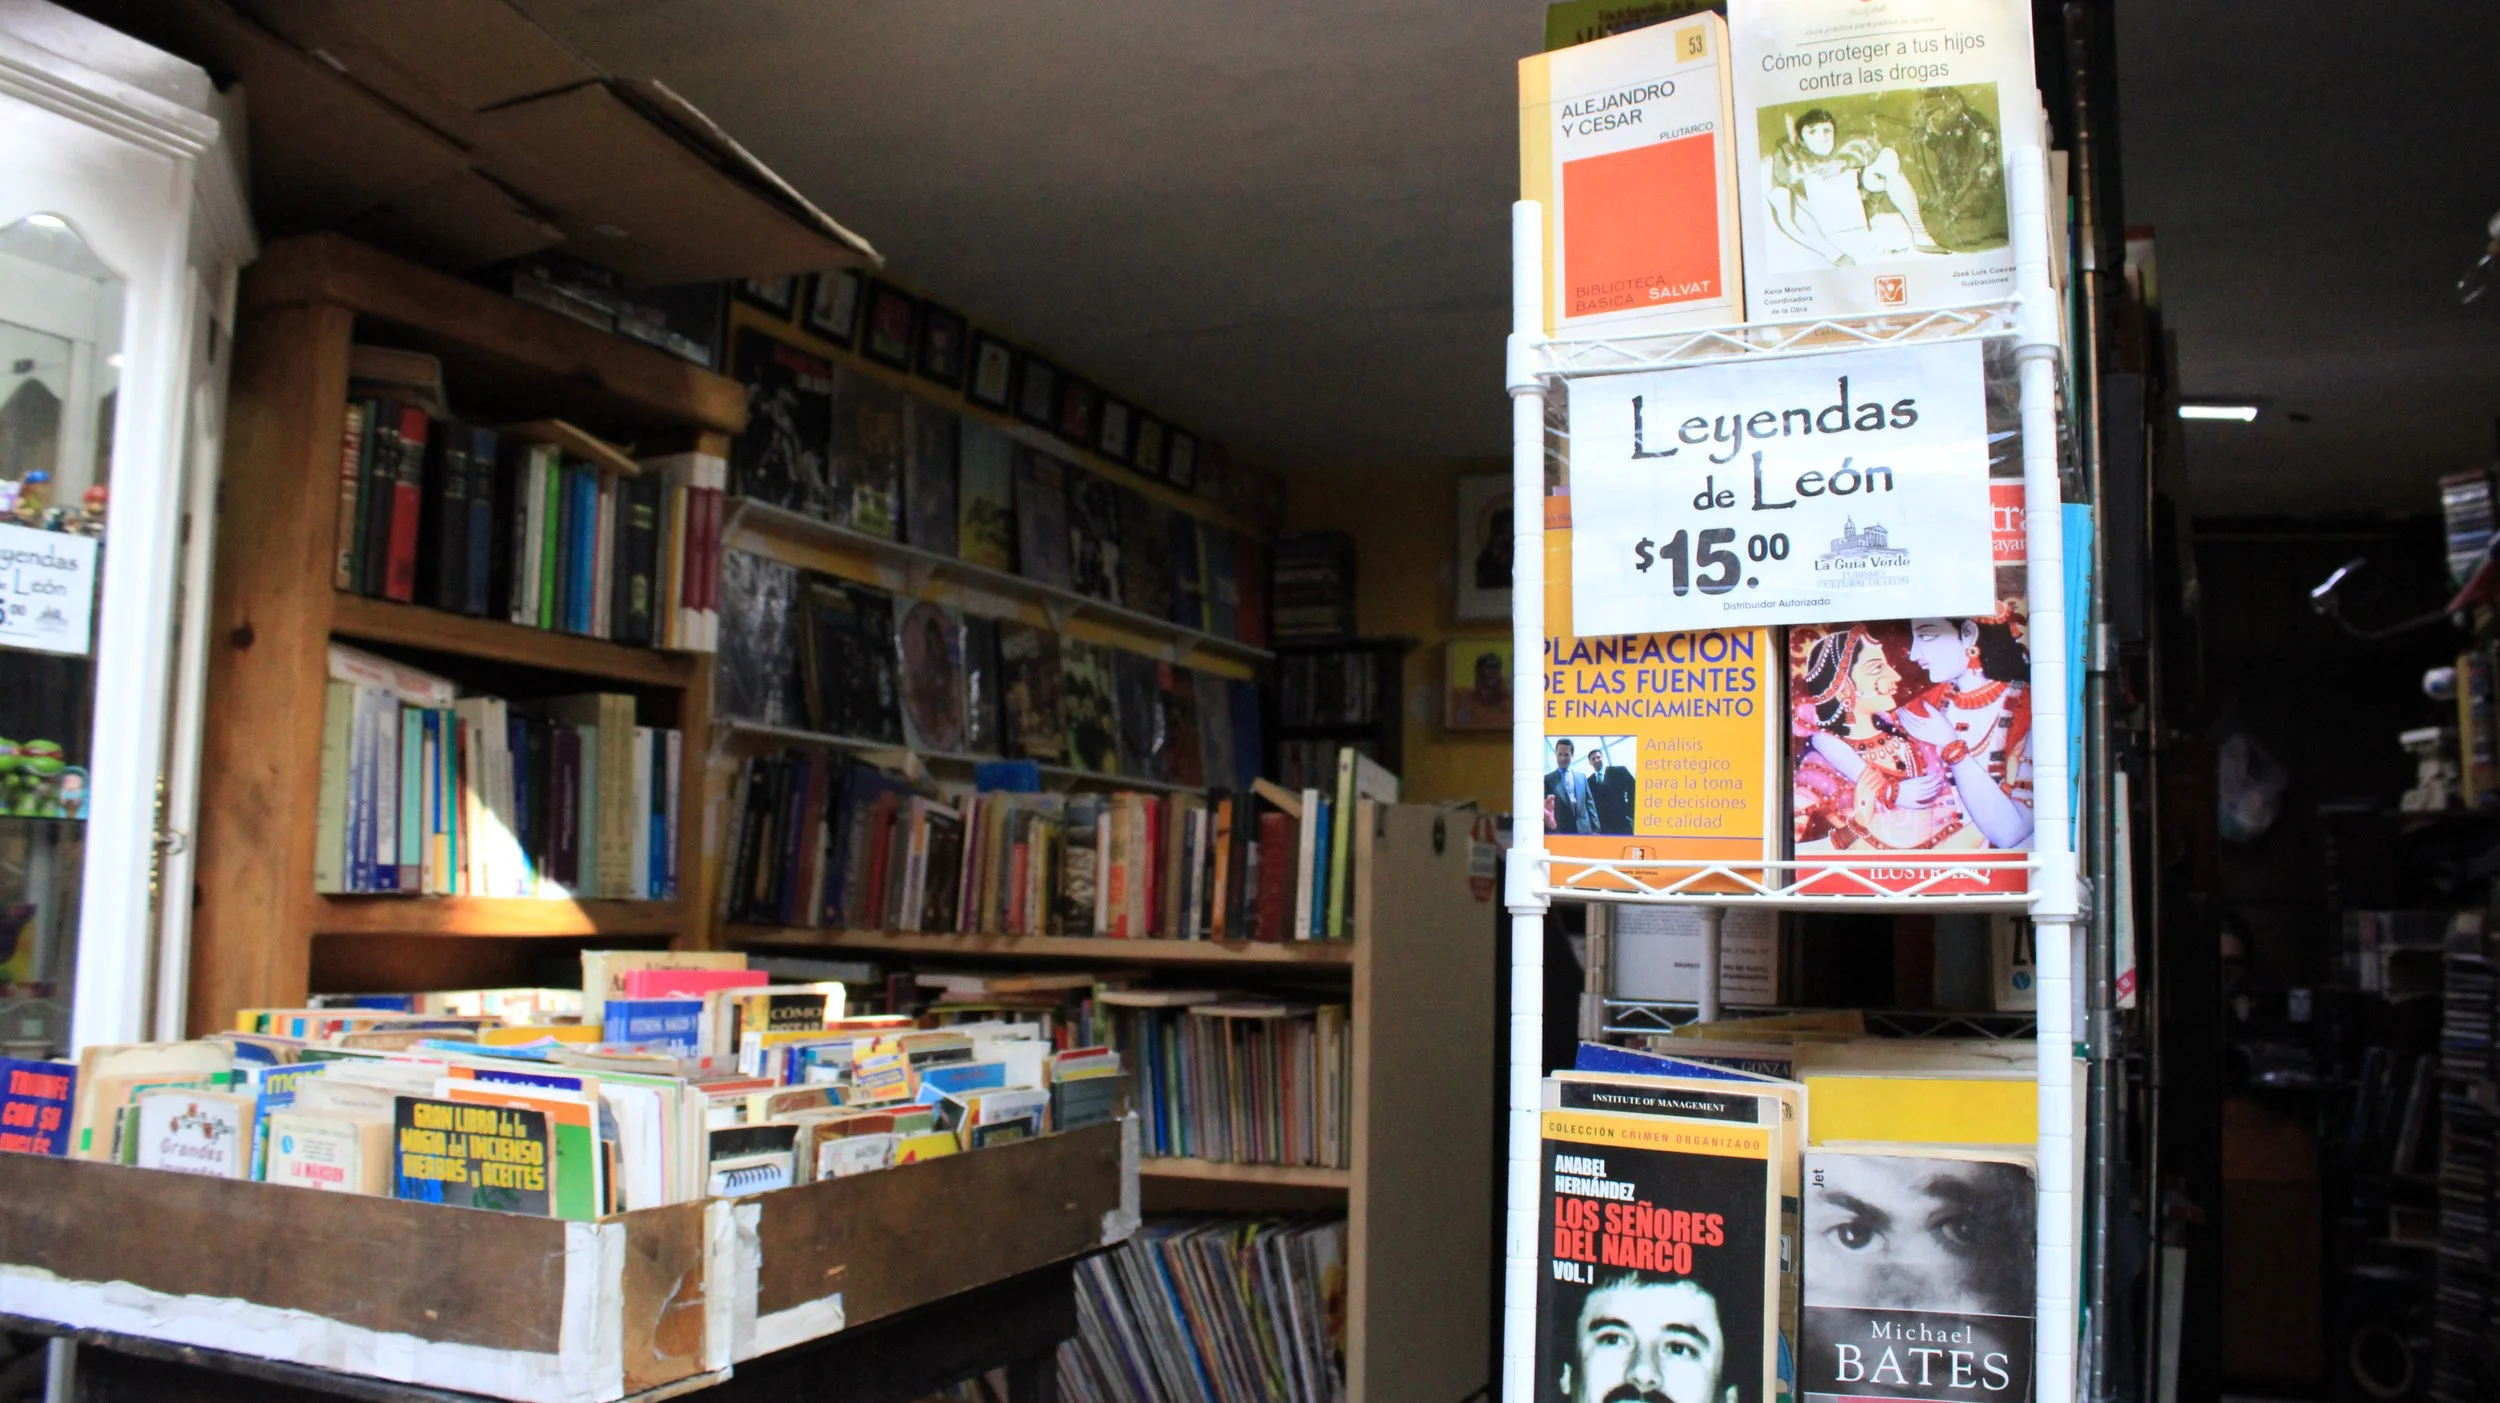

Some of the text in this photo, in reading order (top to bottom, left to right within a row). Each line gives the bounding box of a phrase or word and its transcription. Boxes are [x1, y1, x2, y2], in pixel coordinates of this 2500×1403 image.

[1688, 35, 1703, 55] 53
[1762, 32, 1985, 72] Cómo proteger a tus hijos
[1799, 63, 1949, 91] contra las drogas
[1561, 80, 1675, 120] ALEJANDRO
[1562, 109, 1643, 138] Y CESAR
[1659, 121, 1714, 141] PLUTARCO
[1971, 267, 1988, 276] Luis
[1576, 275, 1666, 299] BIBLIOTECA
[1648, 280, 1711, 300] SALVAT
[1576, 293, 1634, 313] BASICA
[1764, 295, 1813, 306] Coordinadora
[1631, 375, 1919, 464] Leyendas
[1693, 450, 1894, 511] de León
[1635, 527, 1790, 597] $15.00
[1814, 559, 1830, 571] La
[1870, 555, 1911, 568] Verde
[1723, 596, 1831, 612] Distribuidor Autorizado
[1577, 669, 1626, 694] LAS
[1637, 667, 1756, 694] FUENTES
[1565, 697, 1754, 718] FINANCIAMIENTO
[1645, 736, 1703, 752] Análisis
[1645, 756, 1731, 774] estratégico
[1645, 776, 1743, 792] para la toma
[1643, 794, 1747, 809] de decisiones
[1643, 813, 1722, 829] de calidad
[1592, 1093, 1727, 1113] INSTITUTE OF MANAGEMENT
[413, 1103, 453, 1130] GRAN
[455, 1107, 498, 1135] LIBRO
[1549, 1121, 1760, 1151] COLECCIÓN CRIMEN ORGANIZADO
[469, 1134, 544, 1166] INCIENSO
[481, 1161, 545, 1191] ACEITES
[1555, 1154, 1607, 1178] ANABEL
[1555, 1174, 1635, 1202] HERNÁNDEZ
[1812, 1169, 1824, 1189] Jet
[1555, 1196, 1725, 1247] LOS SEÑORES
[1554, 1226, 1693, 1275] DEL NARCO
[1553, 1260, 1594, 1285] VOL. I
[1871, 1320, 1973, 1344] Michael
[1835, 1343, 2010, 1391] BATES
